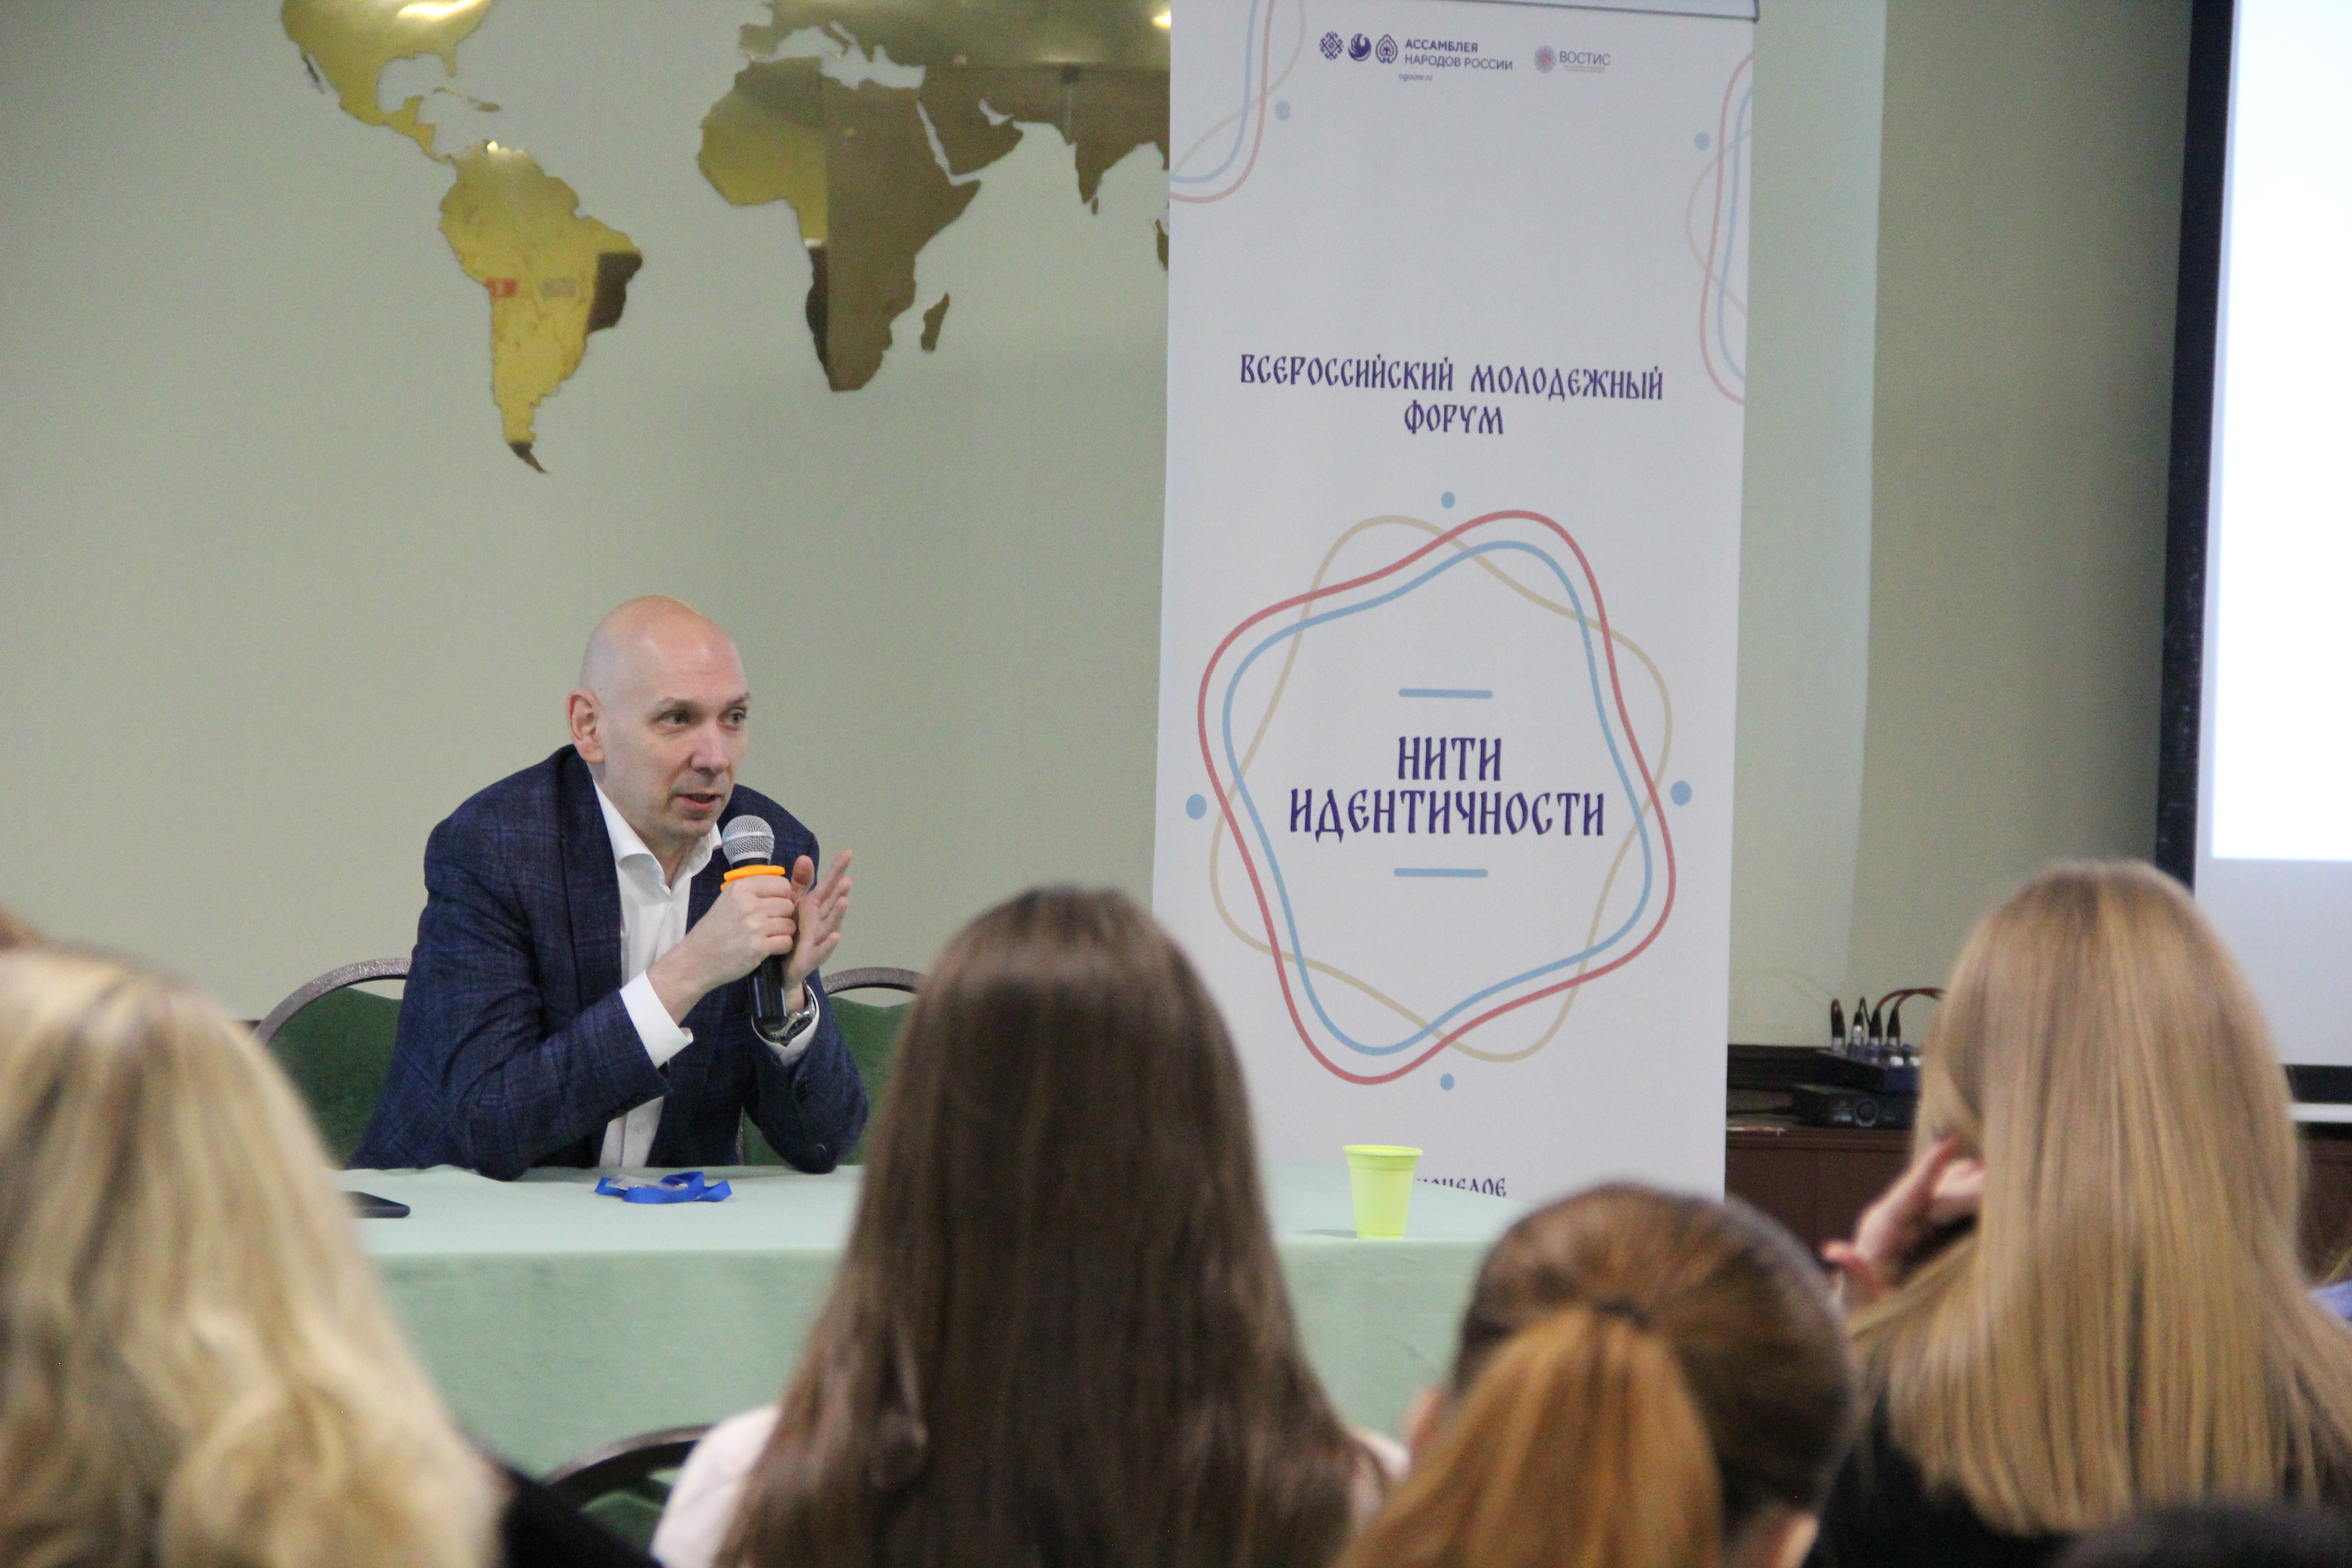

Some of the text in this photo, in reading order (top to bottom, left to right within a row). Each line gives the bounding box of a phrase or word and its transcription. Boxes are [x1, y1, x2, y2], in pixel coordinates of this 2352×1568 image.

[1405, 54, 1513, 70] НАРОДОВ РОССИИ
[1406, 39, 1478, 53] АССАМБЛЕЯ
[1560, 51, 1611, 66] ВОСТИС
[1240, 354, 1663, 402] ВСЕРОССИЙСКИЙ МОЛОДЕЖНЫЙ
[1404, 400, 1504, 435] ФОРУМ
[1398, 736, 1502, 782] НИТИ
[1290, 789, 1605, 843] ИДЕНТИЧНОСТИ
